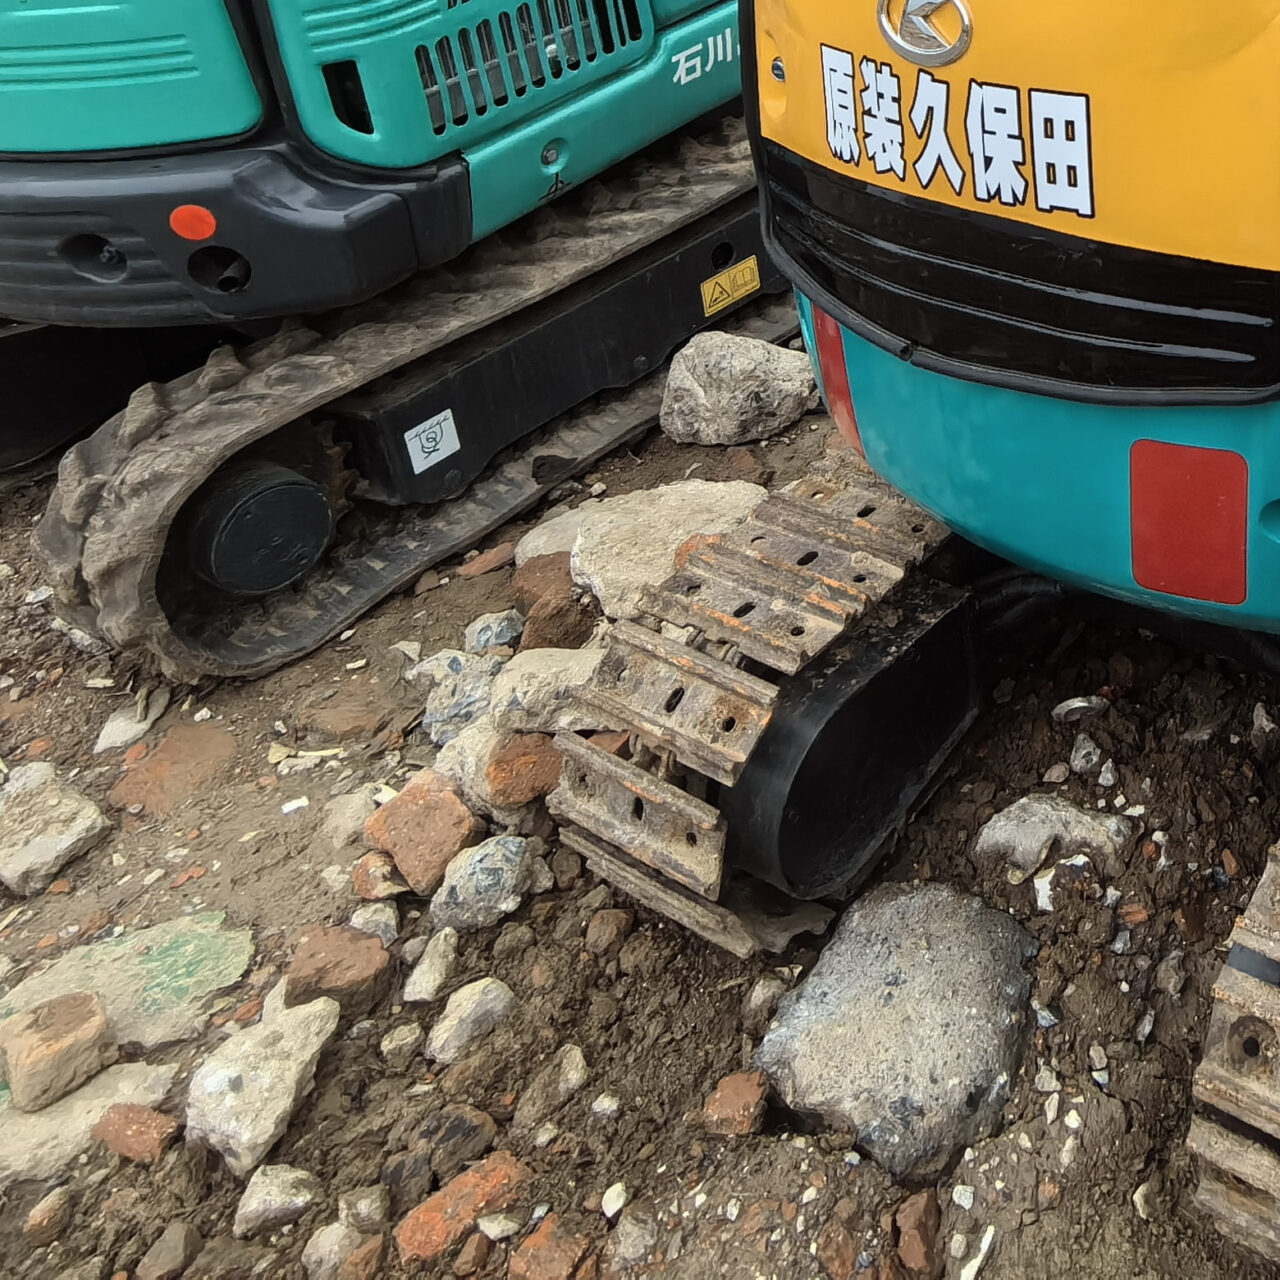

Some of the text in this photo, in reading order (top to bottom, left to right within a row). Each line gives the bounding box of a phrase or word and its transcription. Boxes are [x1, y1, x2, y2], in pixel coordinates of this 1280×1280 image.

[670, 27, 741, 87] 石川
[819, 42, 1096, 219] 原装久保田
